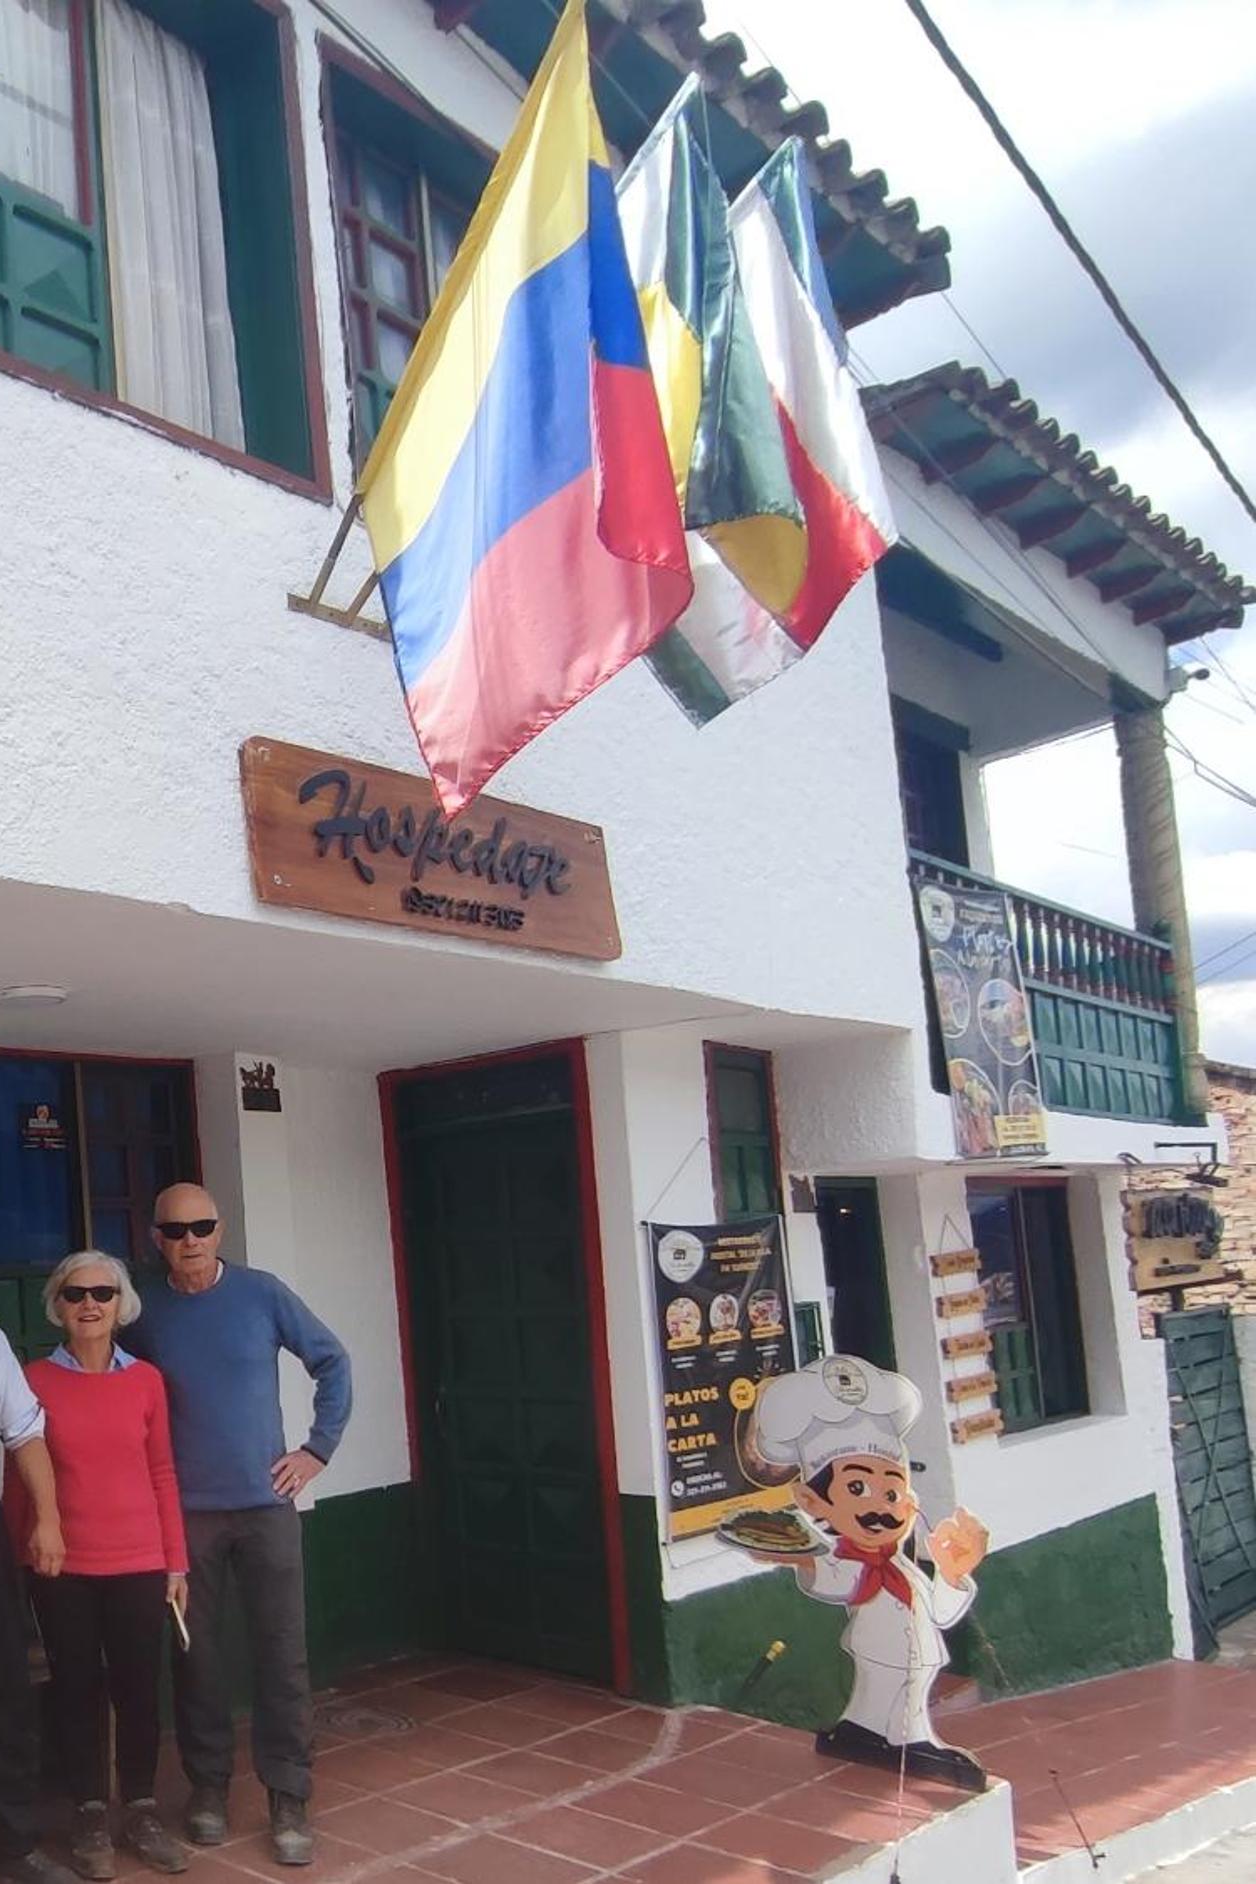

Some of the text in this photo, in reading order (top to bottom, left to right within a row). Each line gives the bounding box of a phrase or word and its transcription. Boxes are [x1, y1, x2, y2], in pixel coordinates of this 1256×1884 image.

[664, 1386, 719, 1407] PLATOS
[666, 1412, 701, 1430] A LA
[667, 1432, 718, 1453] CARTA
